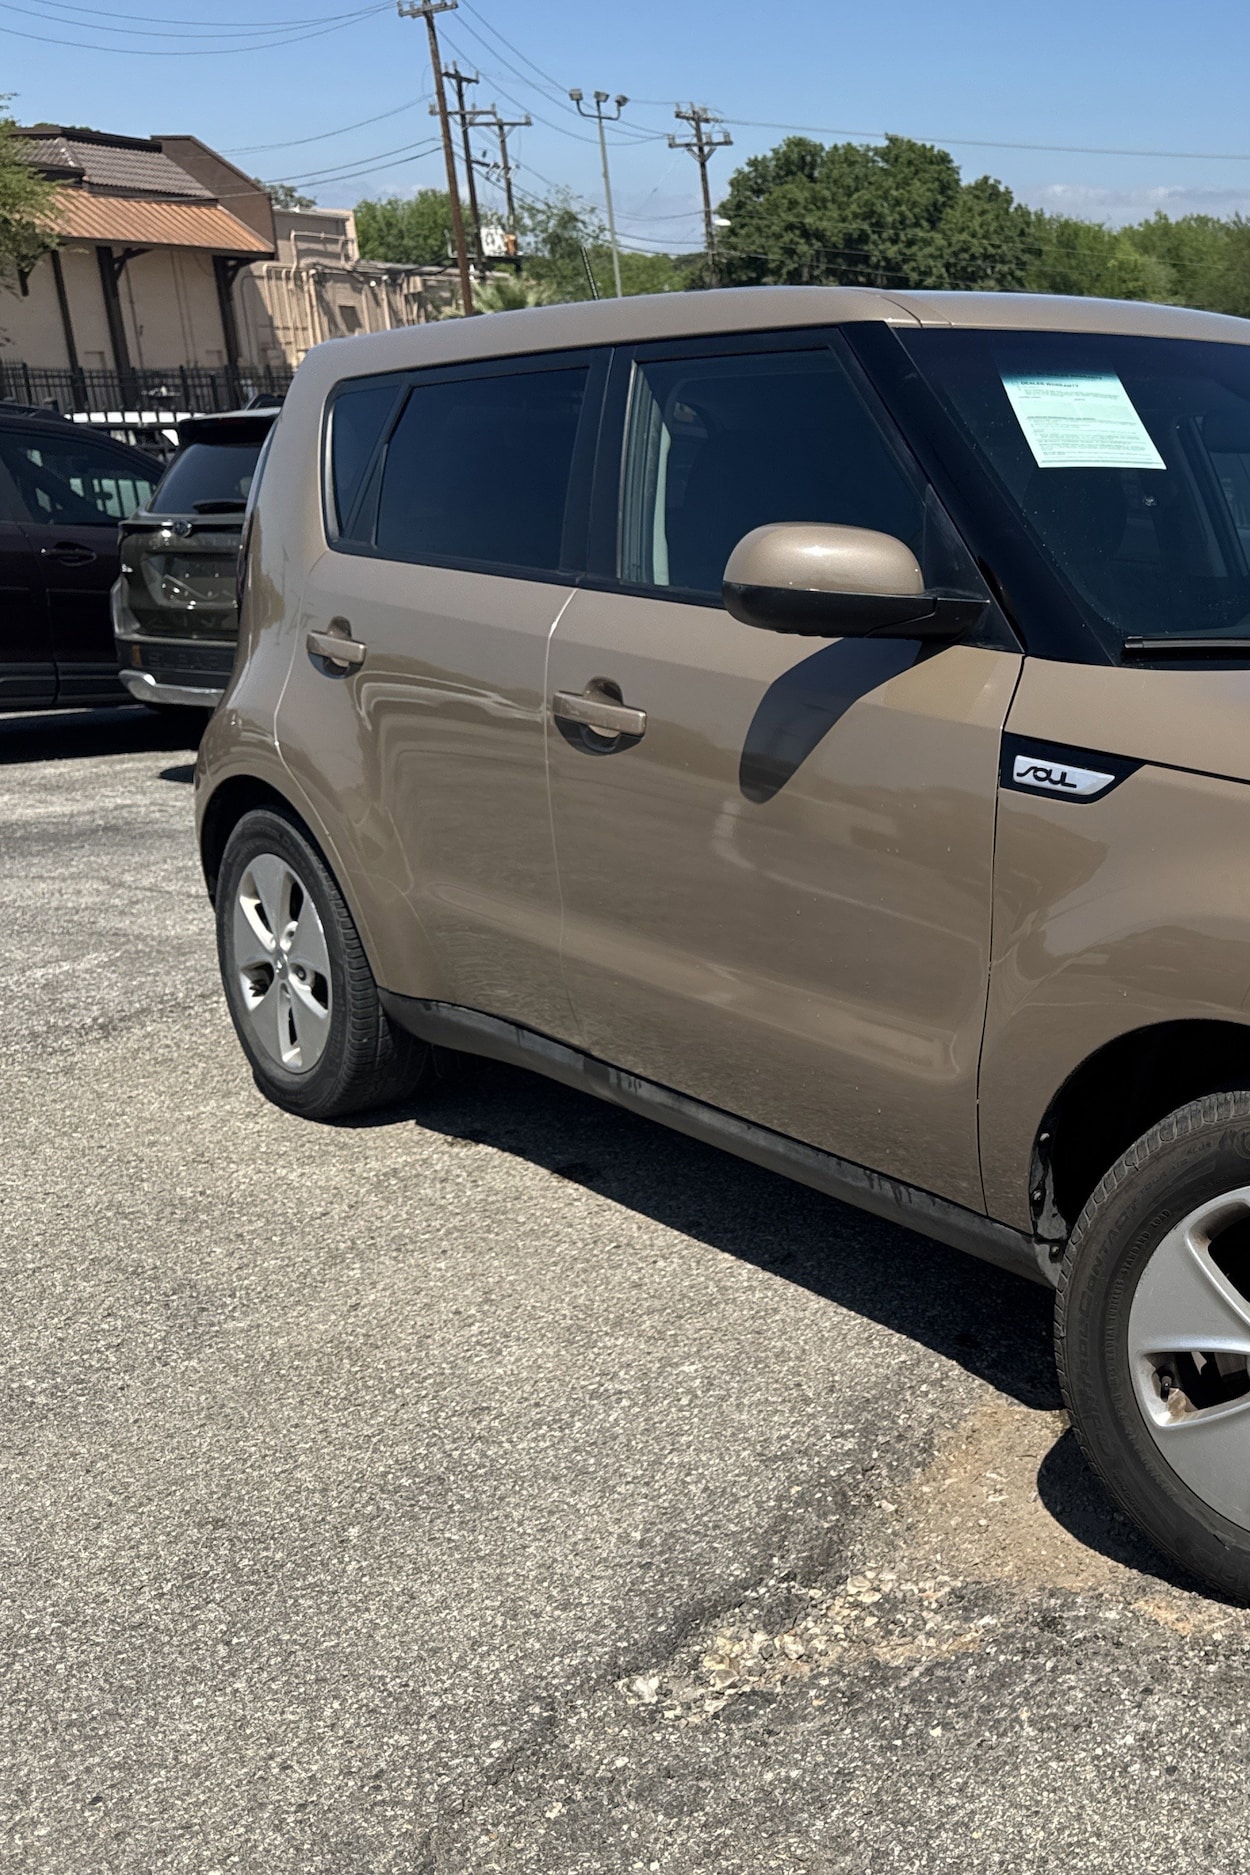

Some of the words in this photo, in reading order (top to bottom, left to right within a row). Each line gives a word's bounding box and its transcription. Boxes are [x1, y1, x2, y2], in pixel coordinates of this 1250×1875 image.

[1016, 765, 1078, 789] SOUL
[1119, 1227, 1153, 1277] STANDARD
[1147, 1205, 1173, 1231] LOAD
